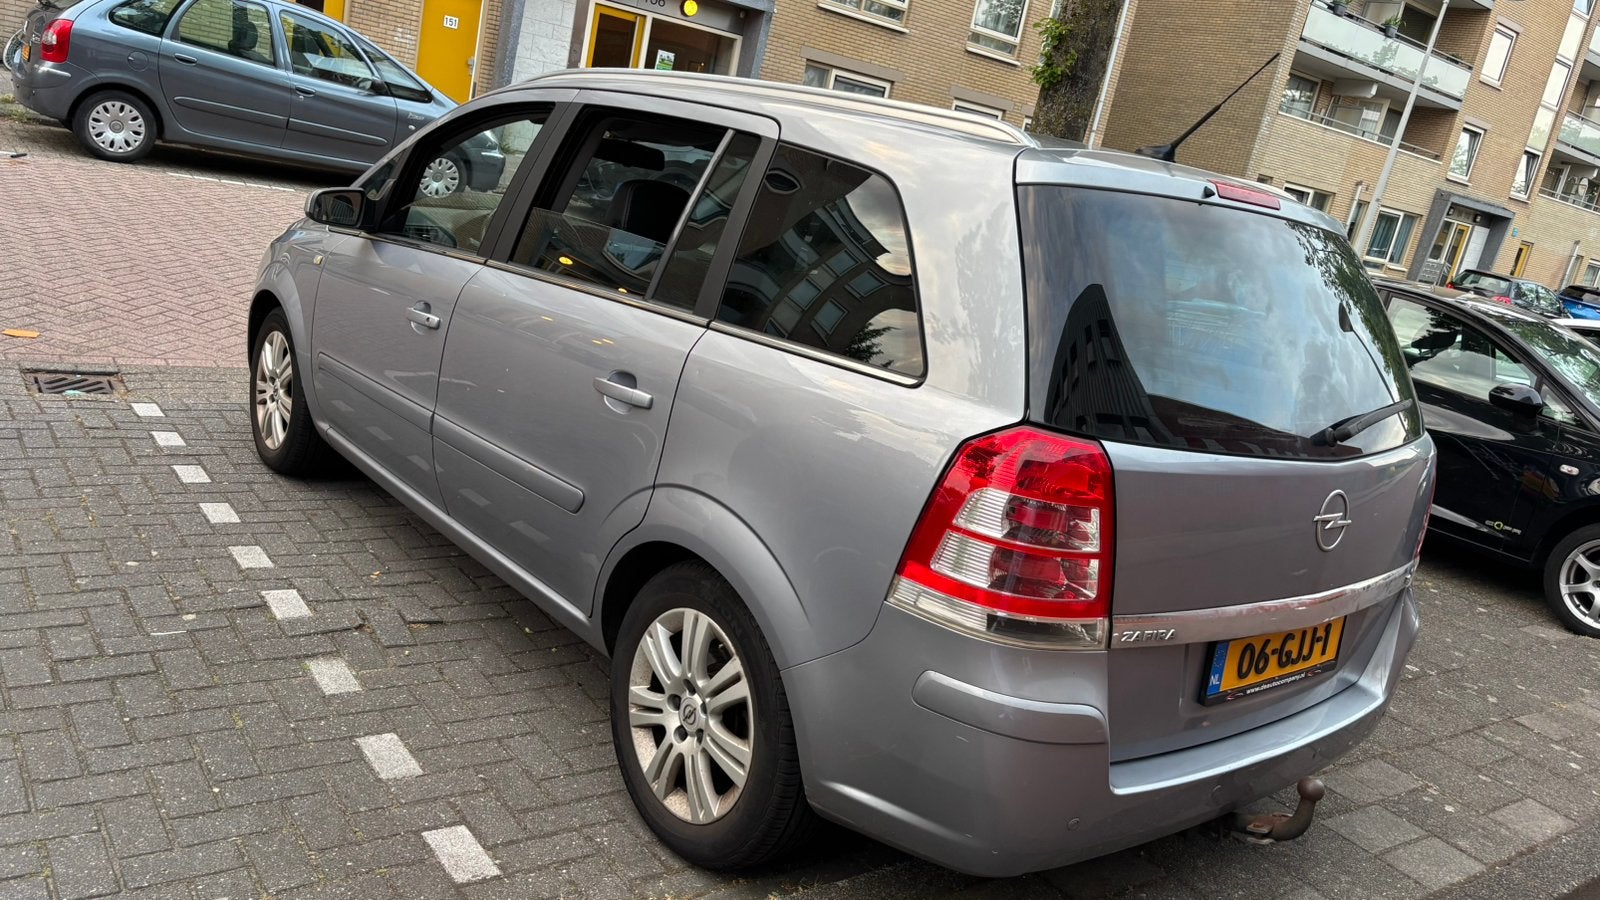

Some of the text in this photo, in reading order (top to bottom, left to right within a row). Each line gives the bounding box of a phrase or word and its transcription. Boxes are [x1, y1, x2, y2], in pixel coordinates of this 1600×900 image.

[445, 16, 457, 27] 151
[1121, 629, 1176, 642] ZAFIRA
[1237, 623, 1333, 680] 06-GJJ-1
[1209, 673, 1220, 686] NL
